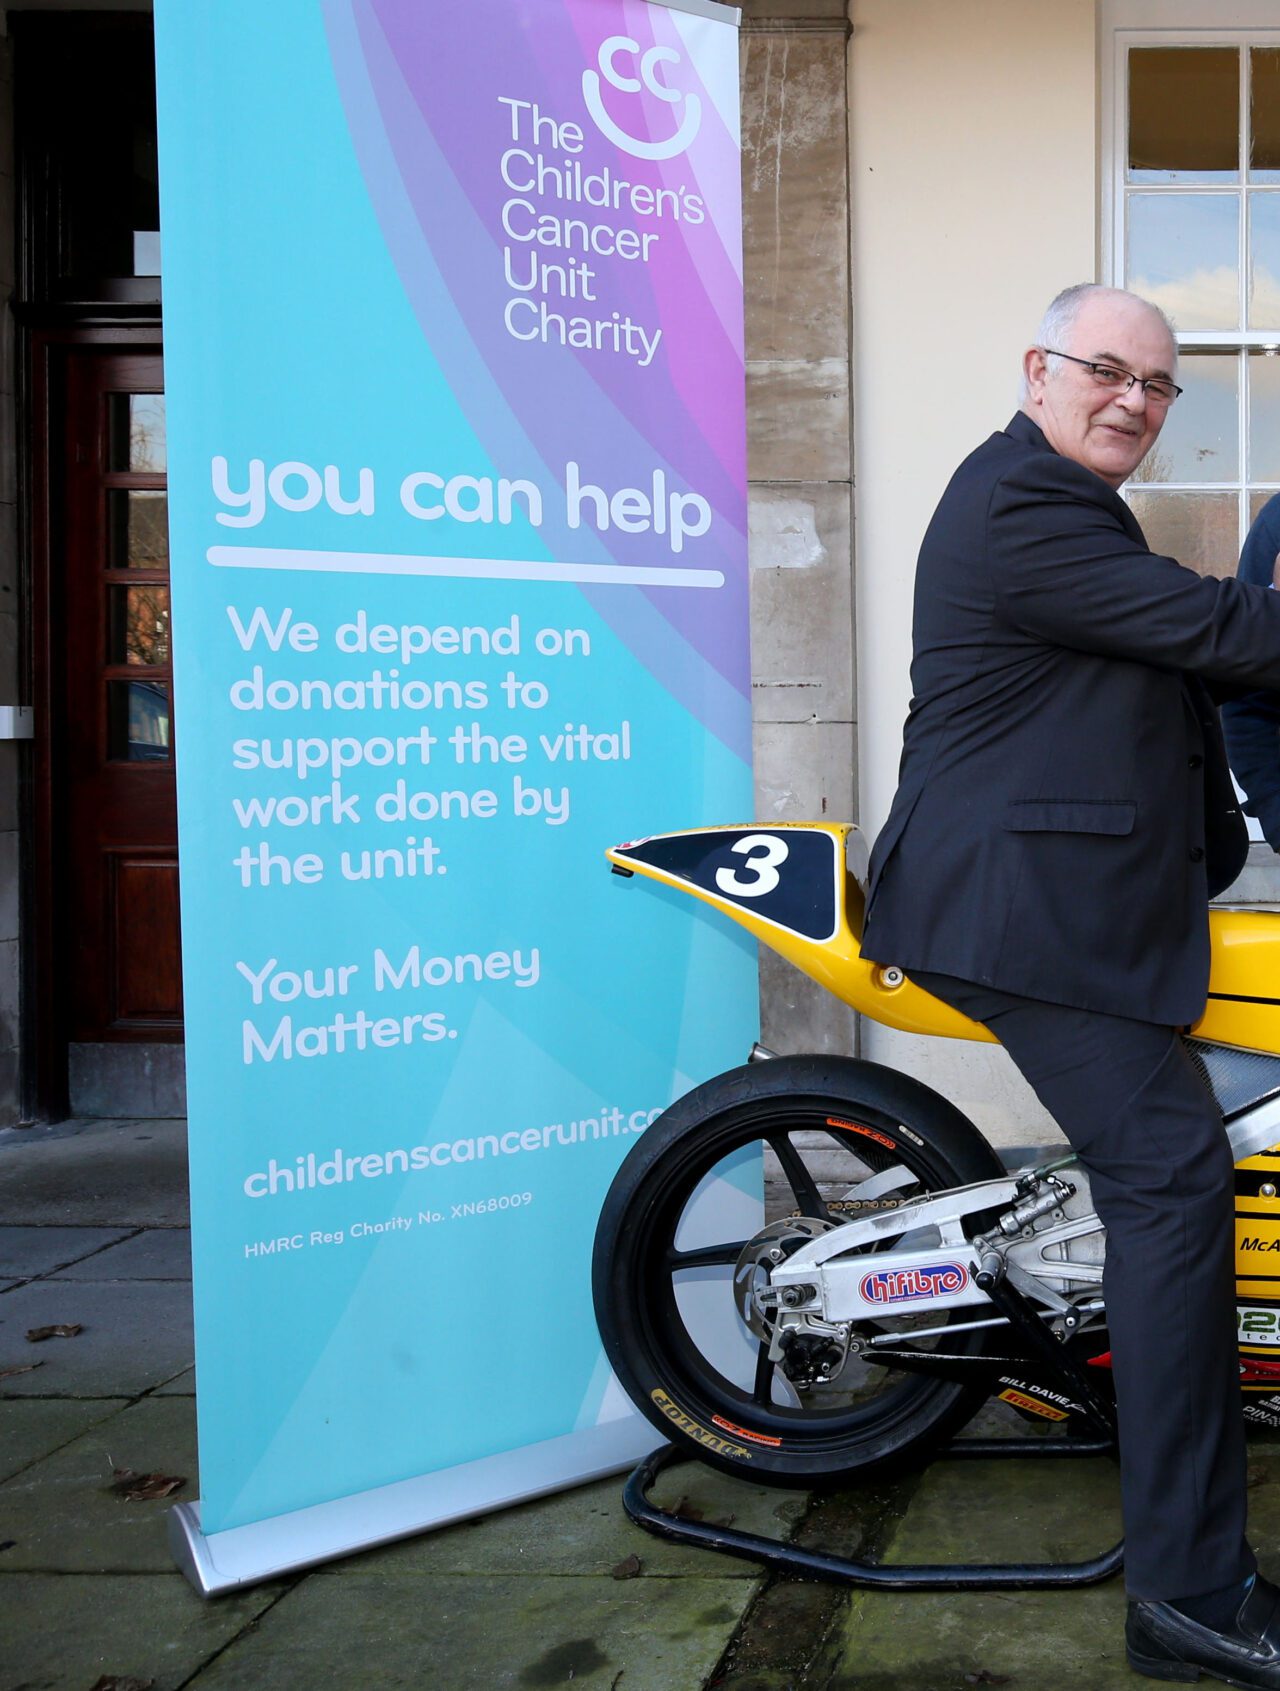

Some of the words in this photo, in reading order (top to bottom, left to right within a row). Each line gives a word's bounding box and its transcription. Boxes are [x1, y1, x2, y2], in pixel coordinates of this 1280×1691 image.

[498, 96, 584, 153] The
[500, 149, 705, 225] Children's
[501, 199, 659, 262] Cancer
[504, 247, 596, 301] Unit
[504, 298, 662, 367] Charity
[211, 455, 375, 529] you
[400, 471, 543, 527] can
[566, 461, 712, 553] help
[227, 605, 319, 653] We
[335, 609, 520, 665] depend
[535, 625, 590, 658] on
[229, 666, 488, 711] donations
[501, 670, 548, 709] to
[232, 726, 437, 779] support
[448, 723, 527, 764] the
[539, 721, 631, 761] vital
[233, 780, 359, 828] work
[375, 779, 498, 825] done
[513, 776, 570, 825] by
[233, 840, 324, 888] the
[341, 836, 447, 880] unit.
[716, 834, 789, 897] 3
[236, 957, 358, 1005] Your
[374, 947, 541, 990] Money
[242, 1010, 457, 1065] Matters.
[244, 1234, 304, 1259] HMRC
[310, 1230, 344, 1247] Reg
[350, 1216, 412, 1240] Charity
[418, 1209, 445, 1225] No.
[451, 1191, 533, 1219] XN68009
[999, 1376, 1026, 1389] BILL
